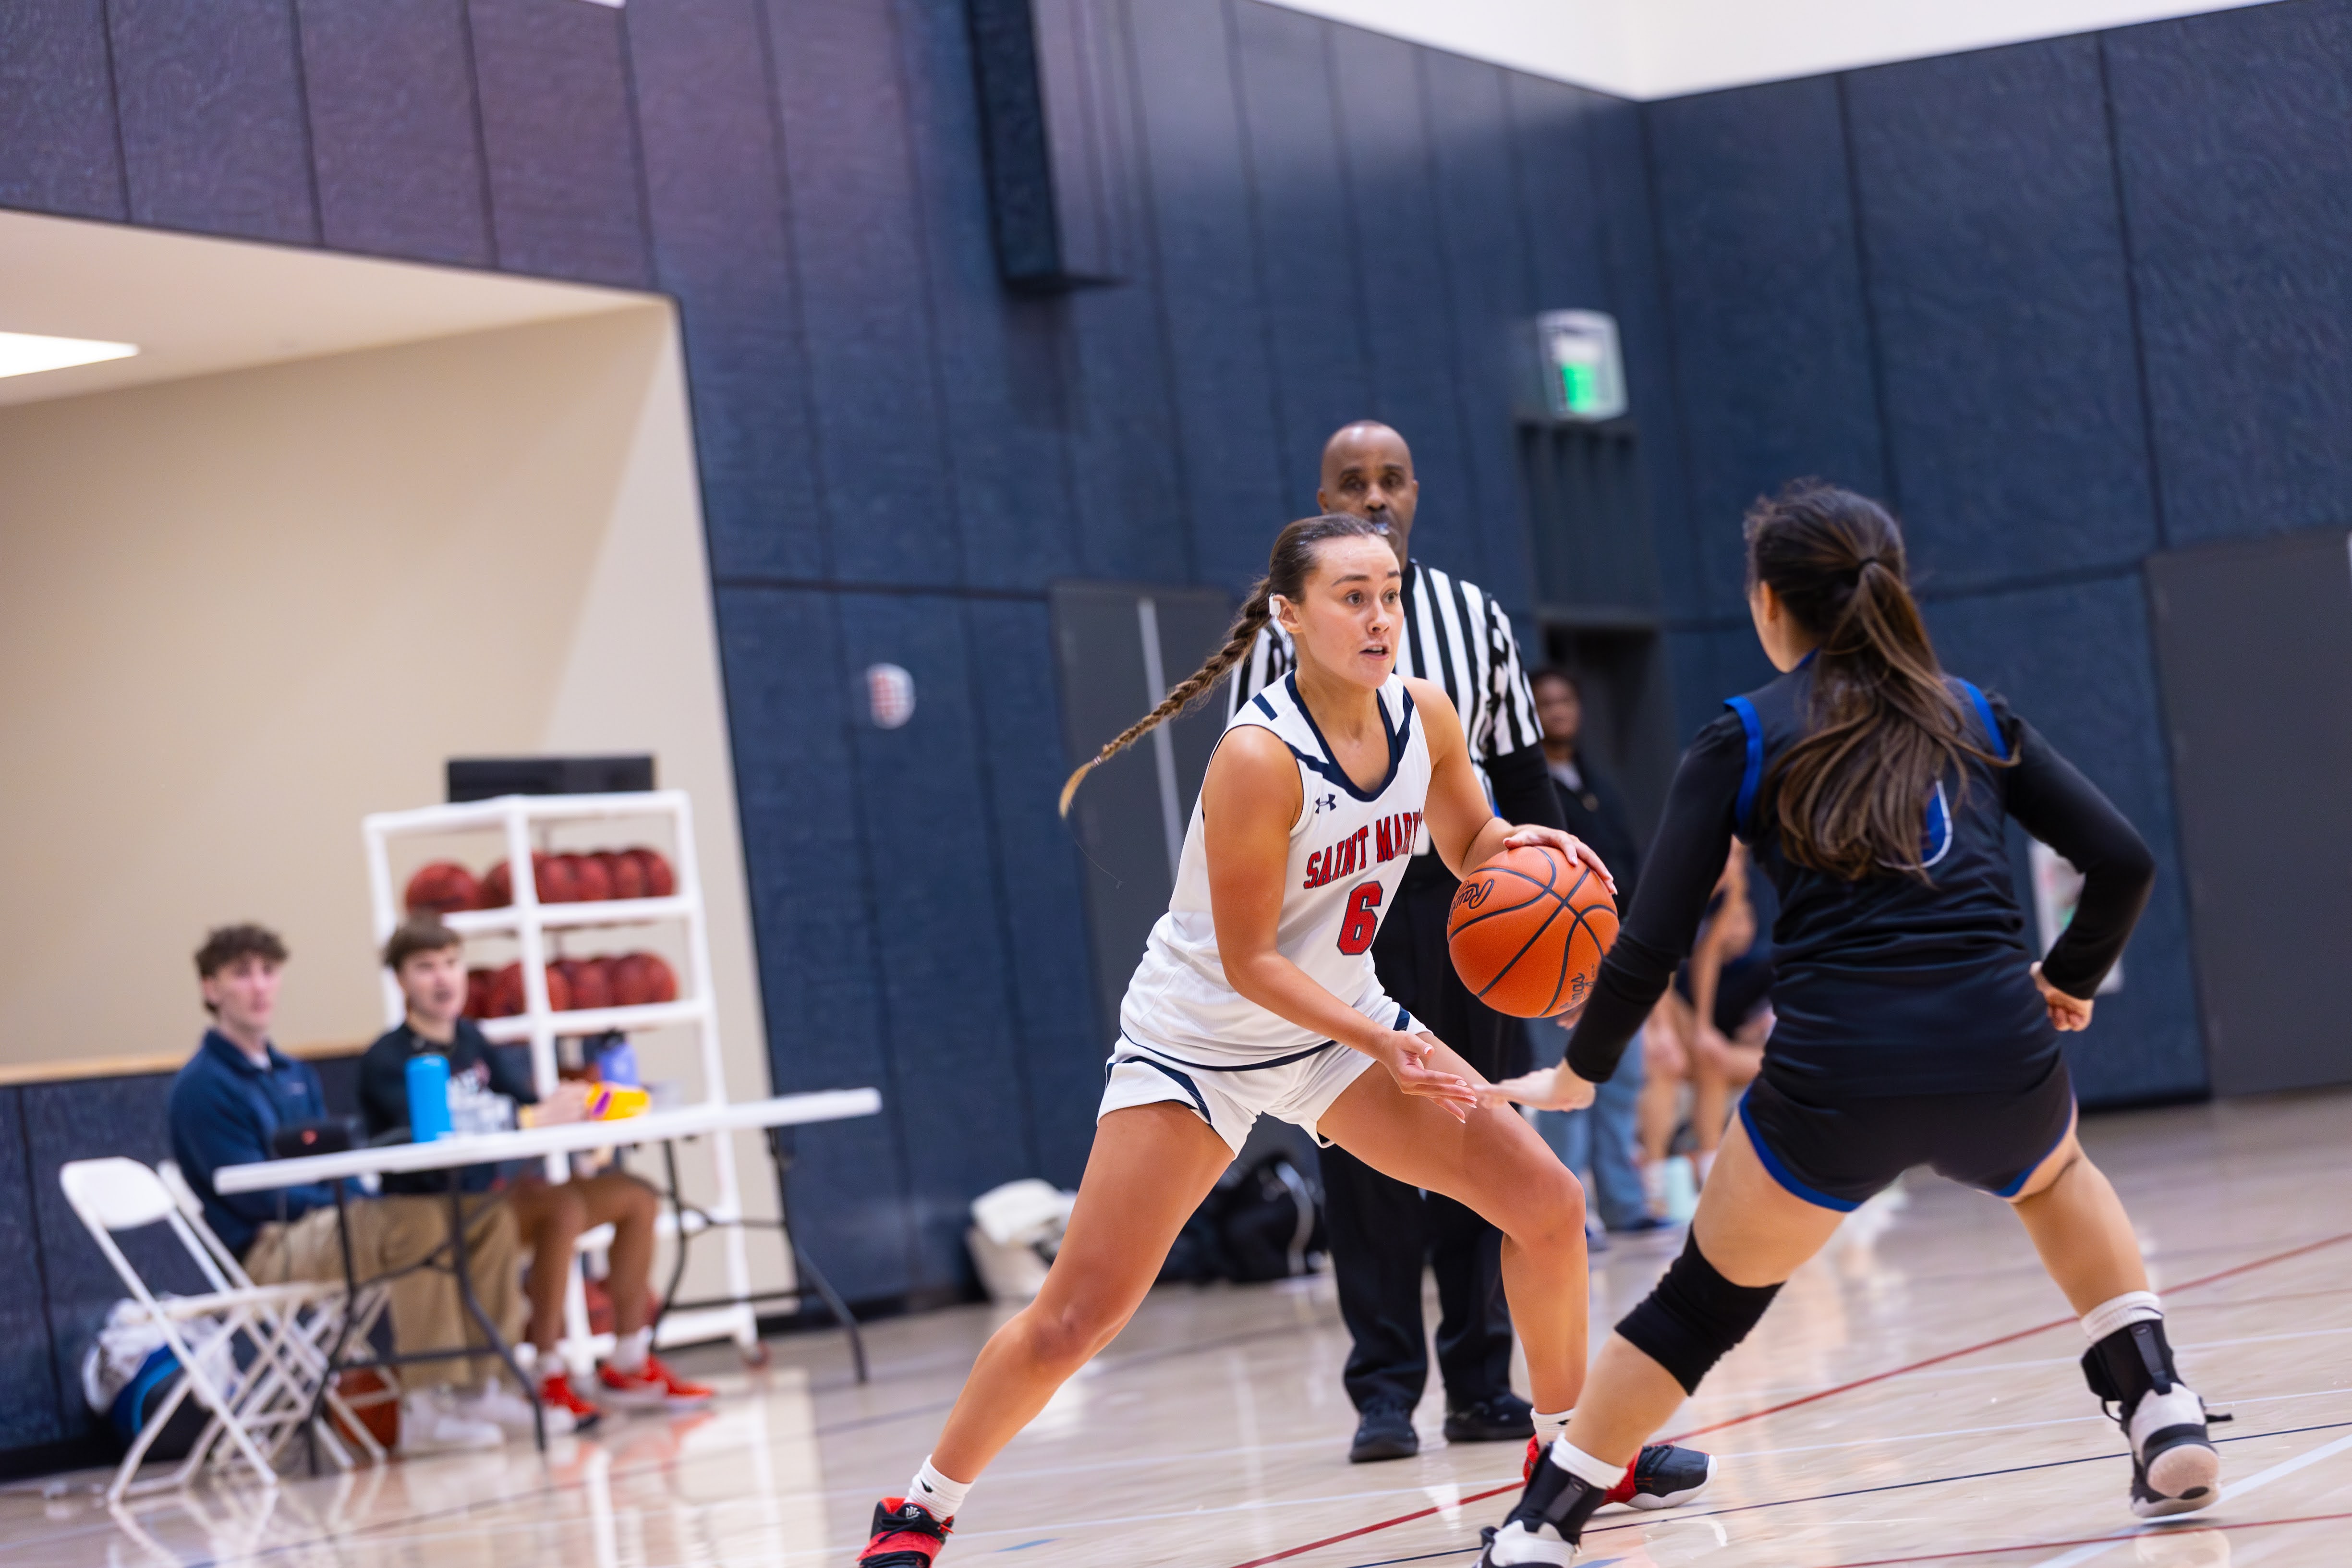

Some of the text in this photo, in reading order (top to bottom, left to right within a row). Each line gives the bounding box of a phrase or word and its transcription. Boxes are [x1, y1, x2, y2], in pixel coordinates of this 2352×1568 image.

[1303, 807, 1423, 889] SAINT MARY'
[1336, 880, 1383, 955] 6
